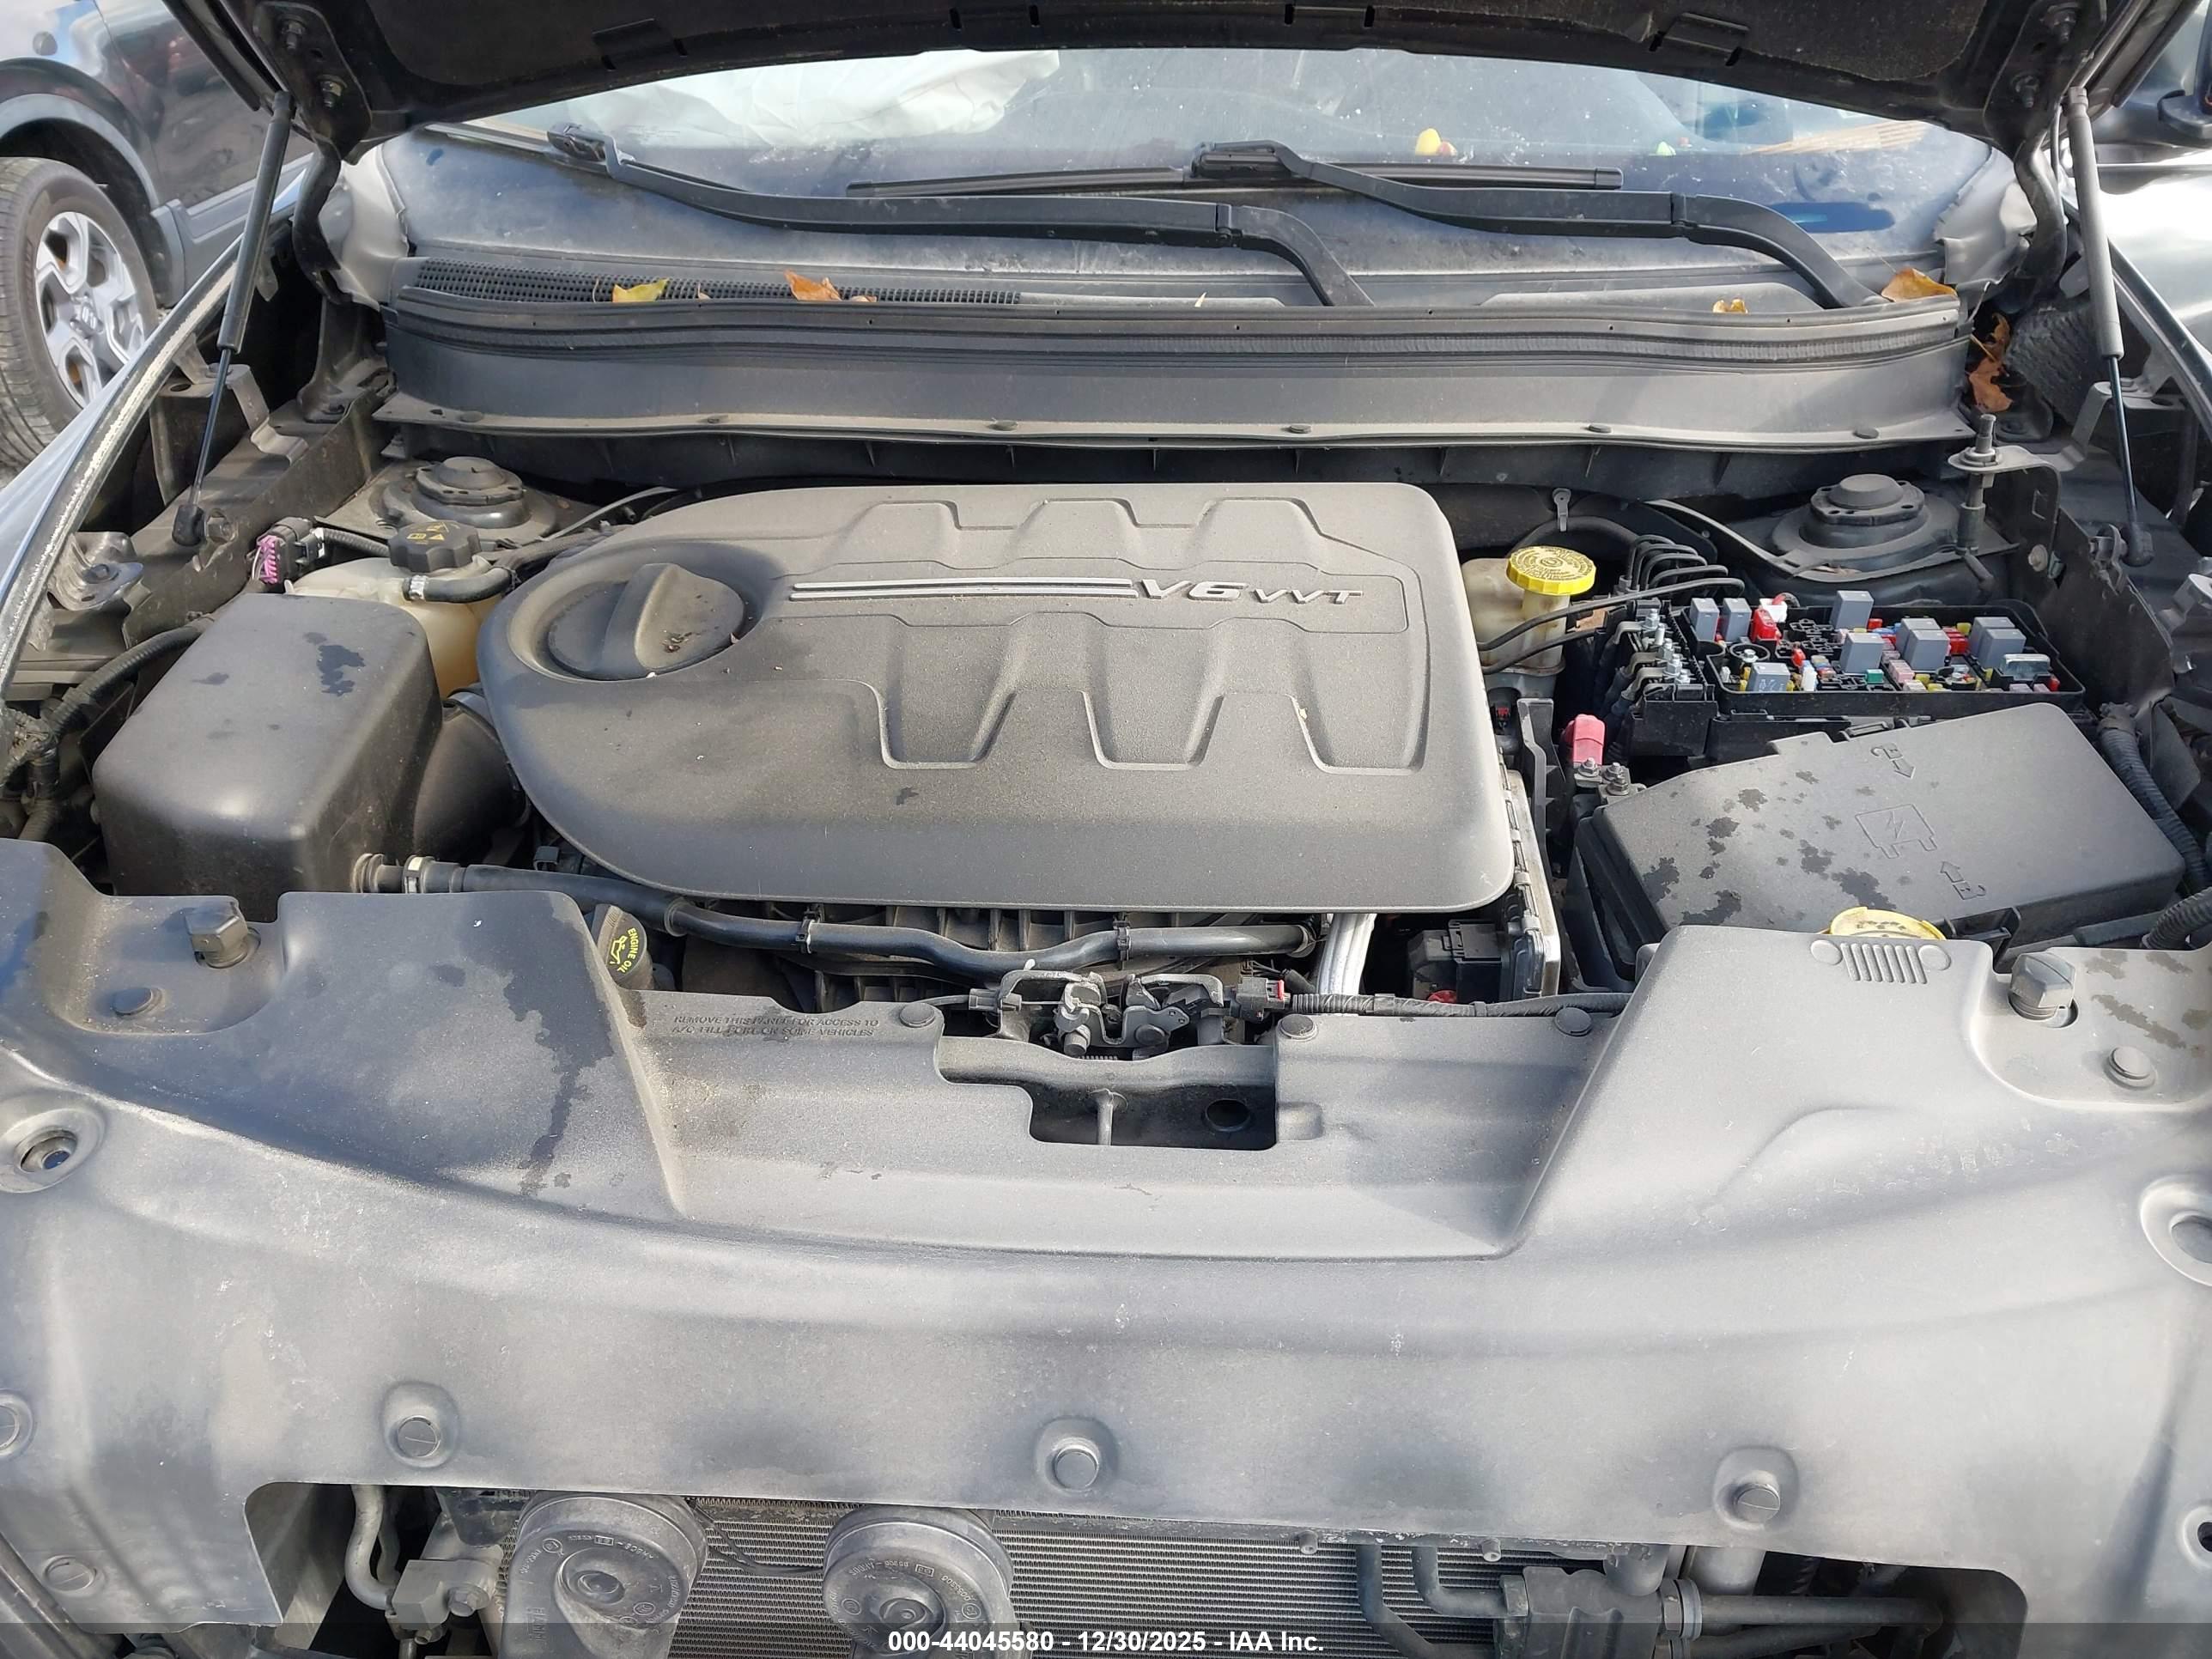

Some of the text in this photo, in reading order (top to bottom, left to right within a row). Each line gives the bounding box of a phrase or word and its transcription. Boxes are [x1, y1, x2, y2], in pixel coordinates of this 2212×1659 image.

[1141, 579, 1364, 604] V6 VVT
[617, 927, 639, 973] ENGINE OIL
[672, 1024, 695, 1034] A/C
[818, 1028, 874, 1036] VEHICLES
[673, 1016, 722, 1024] REMOVE
[724, 1017, 751, 1025] THIS
[817, 1018, 861, 1027] ACCESS
